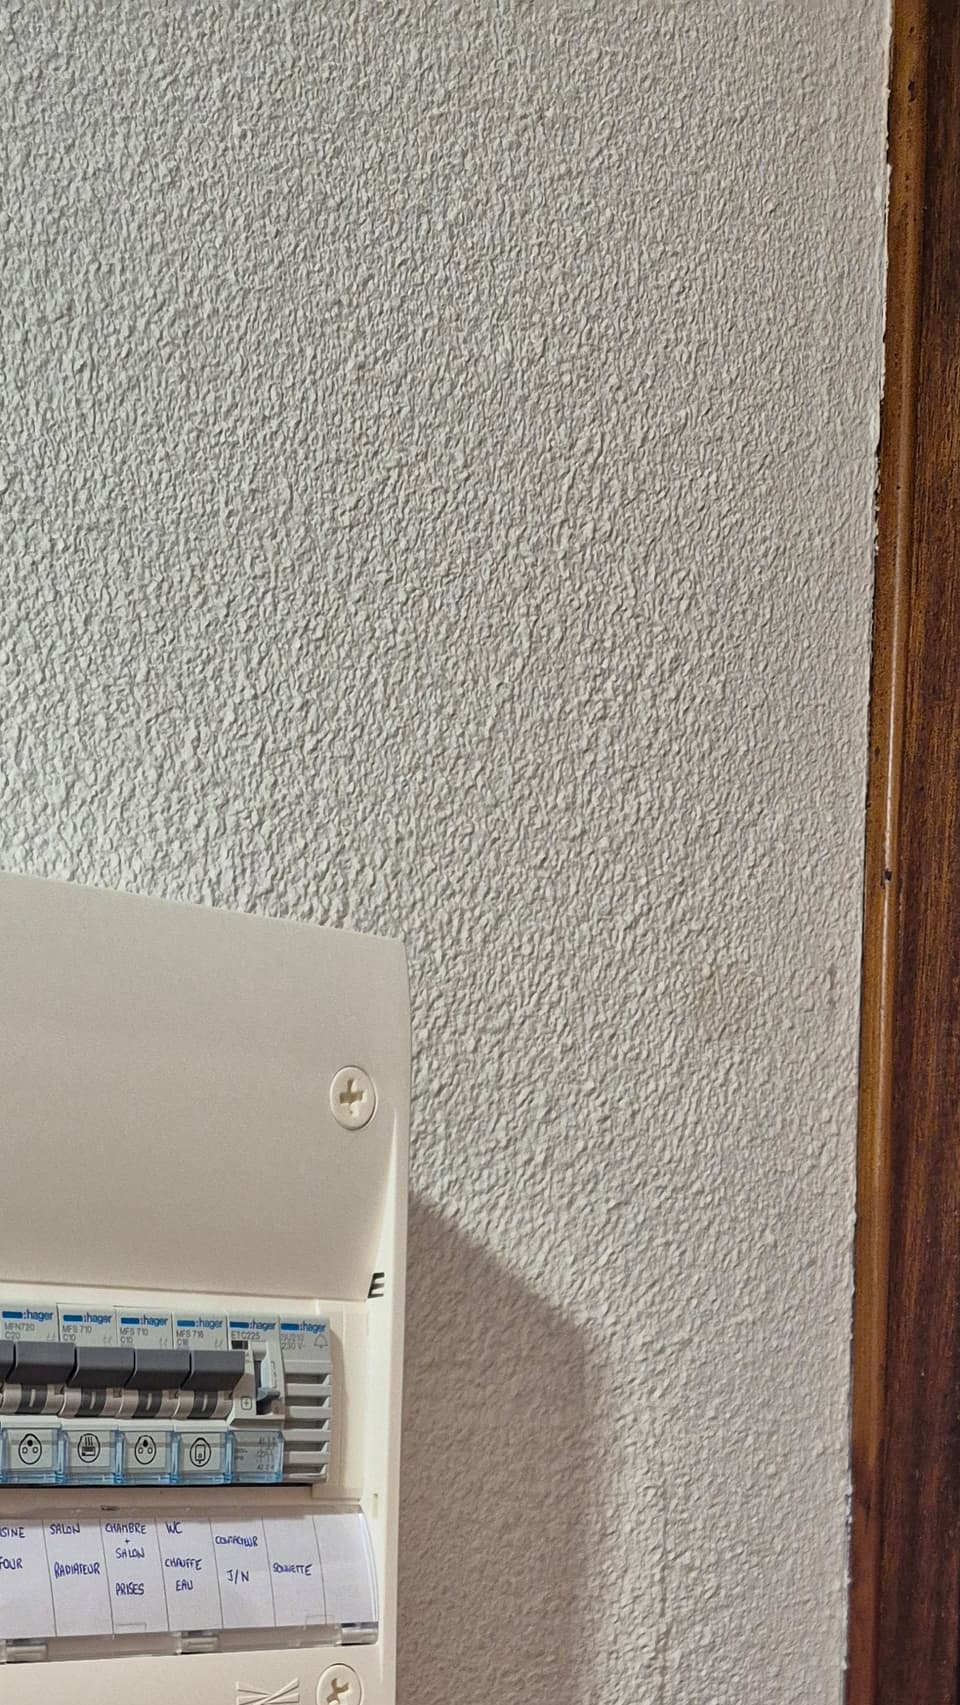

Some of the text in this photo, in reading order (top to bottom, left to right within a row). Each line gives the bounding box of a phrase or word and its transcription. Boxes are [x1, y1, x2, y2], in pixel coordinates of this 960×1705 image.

[49, 1523, 81, 1535] SALON
[104, 1522, 147, 1535] CHAMBRE
[165, 1520, 183, 1534] WC
[115, 1547, 145, 1559] SALON
[54, 1561, 101, 1580] RADIATEUR
[164, 1557, 203, 1571] CHAUFFE
[115, 1581, 145, 1597] PRISES
[175, 1580, 194, 1592] EAU
